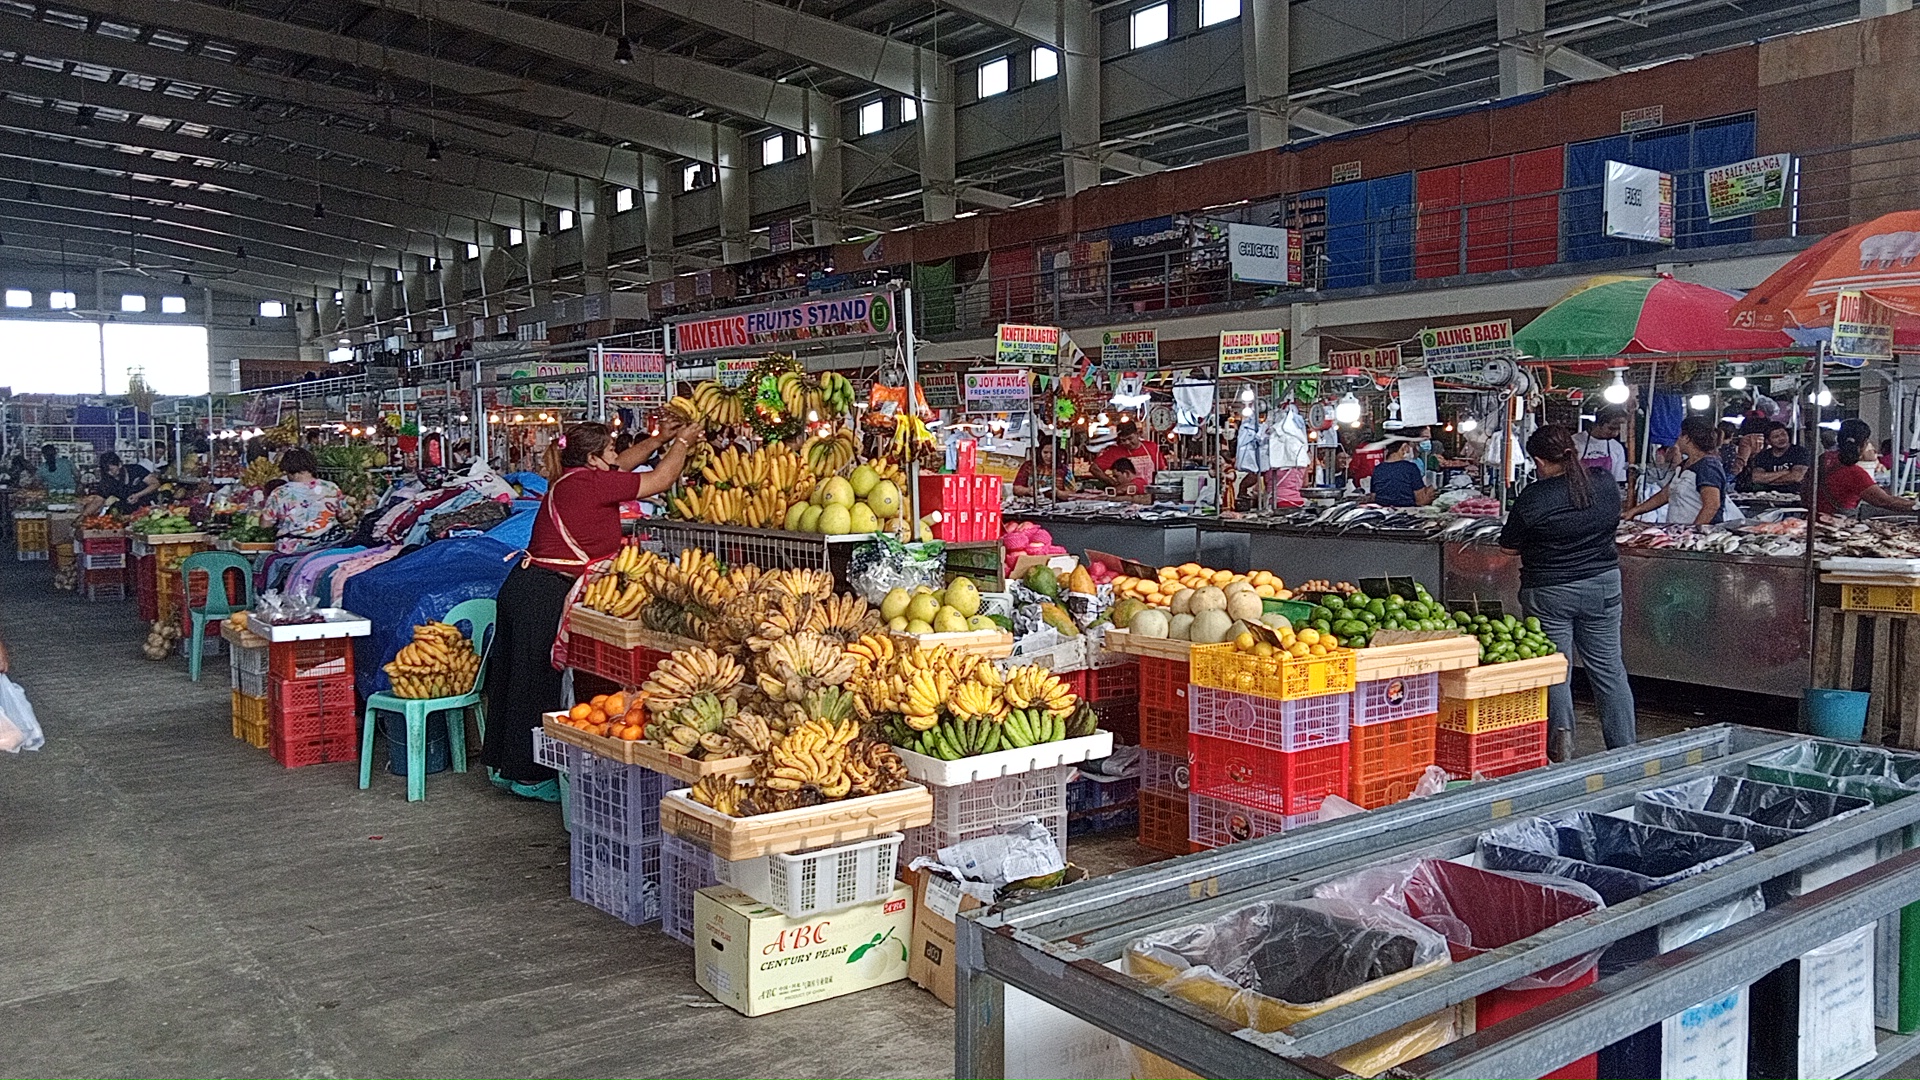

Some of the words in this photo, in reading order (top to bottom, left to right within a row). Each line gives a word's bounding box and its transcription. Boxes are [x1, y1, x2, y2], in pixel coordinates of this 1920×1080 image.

[1709, 169, 1724, 183] FOR
[1725, 164, 1743, 179] SALE
[1745, 156, 1780, 175] NGA-NGA
[1624, 186, 1642, 207] FISH
[1238, 241, 1280, 260] CHICKEN
[679, 315, 747, 352] MAYETH'S
[748, 308, 803, 333] FRUITS
[807, 299, 867, 326] STAND
[1437, 327, 1472, 347] ALING
[1473, 322, 1507, 342] BABY
[1839, 324, 1859, 334] FRESH
[1001, 326, 1025, 342] NENETH
[1026, 328, 1057, 344] BALAGTAS
[1121, 330, 1154, 344] NENETH
[1223, 334, 1239, 347] ALING
[1239, 333, 1254, 347] BABY
[1261, 332, 1280, 345] NANDO
[1018, 342, 1042, 350] SEAFOODS
[1452, 345, 1467, 353] STORE
[1330, 351, 1362, 370] EDITH
[1364, 353, 1373, 369] &
[1375, 349, 1398, 368] APO
[926, 375, 955, 387] ATAYDE
[979, 377, 994, 388] JOY
[762, 921, 831, 955] ABC
[760, 952, 813, 971] CENTURY
[815, 944, 849, 960] PEARS
[785, 992, 805, 1000] PRODUCT
